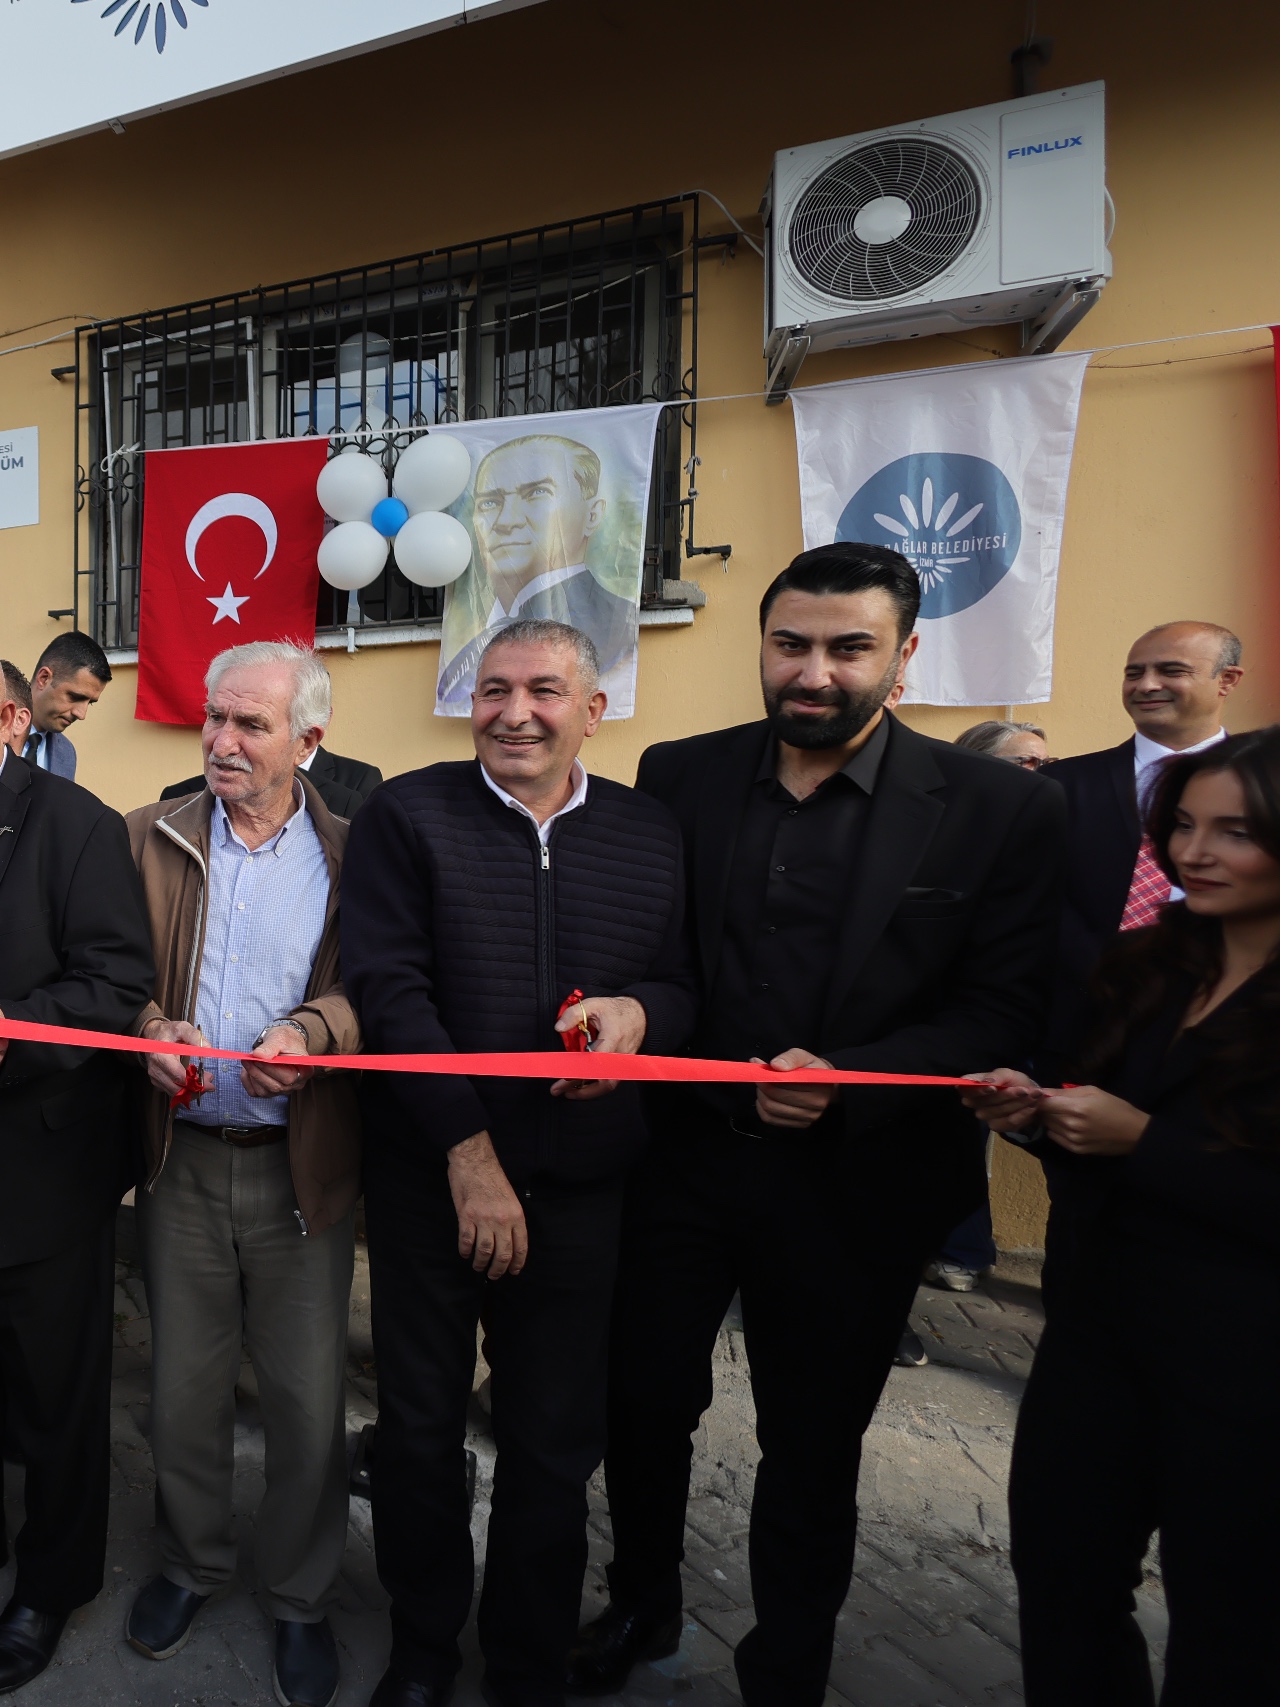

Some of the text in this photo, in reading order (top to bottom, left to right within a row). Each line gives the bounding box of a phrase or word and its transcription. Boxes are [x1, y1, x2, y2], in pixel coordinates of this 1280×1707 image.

[1007, 135, 1083, 160] FINLUX
[931, 532, 1007, 555] BELEDİYESİ
[919, 556, 934, 568] İZMİR
